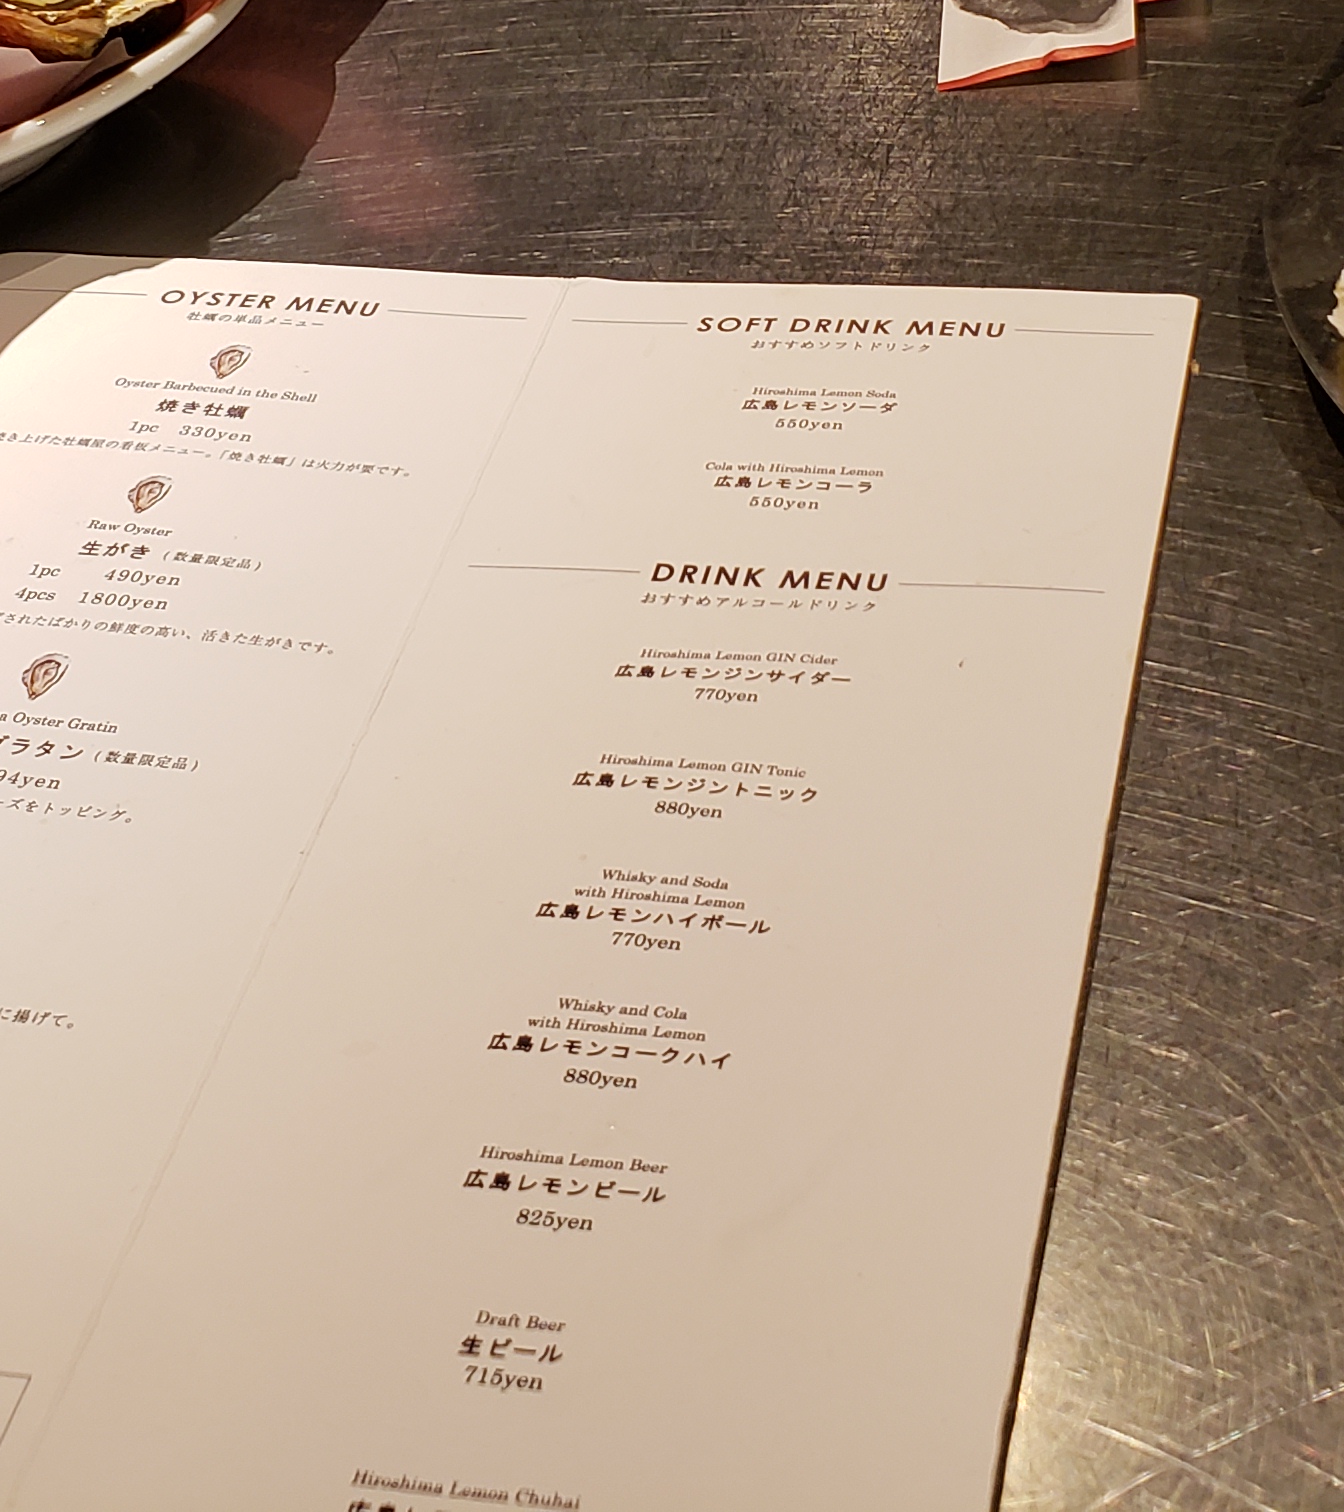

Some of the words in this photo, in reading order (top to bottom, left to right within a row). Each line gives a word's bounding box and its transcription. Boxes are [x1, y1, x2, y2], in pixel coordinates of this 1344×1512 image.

[160, 290, 277, 311] OYSTER
[285, 296, 383, 318] MENU
[186, 311, 324, 328] 牡蠣の単品メニュー
[695, 316, 779, 334] SOFT
[788, 318, 894, 336] DRINK
[904, 321, 1008, 339] MENU
[751, 339, 933, 354] おすすめソフトドリンク
[114, 377, 162, 391] Oyster
[164, 380, 235, 396] Barbecued
[237, 385, 252, 396] in
[253, 386, 279, 399] the
[280, 389, 318, 404] Shell
[752, 387, 818, 398] Hiroshima
[819, 388, 863, 399] Lemon
[865, 388, 897, 400] Soda
[154, 398, 252, 421] 焼き牡蠣
[740, 399, 899, 415] 広島レモンソーダ
[128, 420, 161, 436] 1pc
[178, 424, 253, 444] 330yen
[774, 417, 844, 433] 550yen
[705, 460, 734, 472] Cola
[735, 461, 766, 473] with
[768, 462, 837, 476] Hiroshima
[838, 466, 885, 478] Lemon
[713, 475, 874, 494] 広島レモンコーラ
[748, 495, 821, 512] 550yen
[86, 519, 122, 533] Raw
[123, 523, 173, 539] Oyster
[78, 539, 152, 561] 生がき
[28, 563, 62, 581] 1pc
[103, 567, 182, 588] 490yen
[649, 562, 767, 589] DRINK
[778, 569, 890, 593] MENU
[14, 587, 57, 605] 4pcs
[77, 591, 169, 613] 1800yen
[640, 592, 878, 613] おすすめアルコールドリンク
[639, 648, 712, 662] Hiroshima
[714, 649, 763, 663] Lemon
[765, 651, 797, 664] GIN
[799, 653, 840, 666] Cider
[614, 663, 853, 686] 広島レモンジンサイダー
[693, 687, 759, 705] 770yen
[11, 710, 65, 731] Oyster
[66, 717, 119, 735] Gratin
[599, 753, 674, 769] Hiroshima
[677, 758, 728, 773] Lemon
[730, 761, 763, 775] GIN
[766, 764, 808, 780] Tonic
[571, 770, 820, 804] 広島レモンジントニック
[654, 800, 724, 820] 880yen
[601, 869, 657, 887] Whisky
[659, 873, 690, 888] and
[692, 876, 730, 891] Soda
[573, 885, 608, 900] with
[610, 887, 691, 906] Hiroshima
[693, 896, 747, 911] Lemon
[534, 901, 773, 936] 広島レモンハイボール
[610, 931, 683, 952] 770yen
[557, 997, 616, 1017] Whisky
[618, 1002, 650, 1017] and
[652, 1005, 689, 1021] Cola
[527, 1015, 562, 1031] with
[564, 1017, 650, 1036] Hiroshima
[652, 1024, 707, 1043] Lemon
[486, 1032, 733, 1071] 広島レモンコークハイ
[563, 1068, 639, 1092] 880yen
[479, 1145, 566, 1166] Hiroshima
[568, 1151, 625, 1171] Lemon
[628, 1156, 669, 1175] Beer
[462, 1168, 669, 1205] 広島レモンビール
[515, 1208, 595, 1233] 825yen
[475, 1310, 523, 1329] Draft
[525, 1315, 567, 1333] Beer
[457, 1335, 565, 1365] 生ビール
[463, 1365, 544, 1393] 715yen
[351, 1468, 445, 1495] Hiroshima
[449, 1480, 510, 1502] Lemon
[514, 1488, 582, 1511] Chuhai
